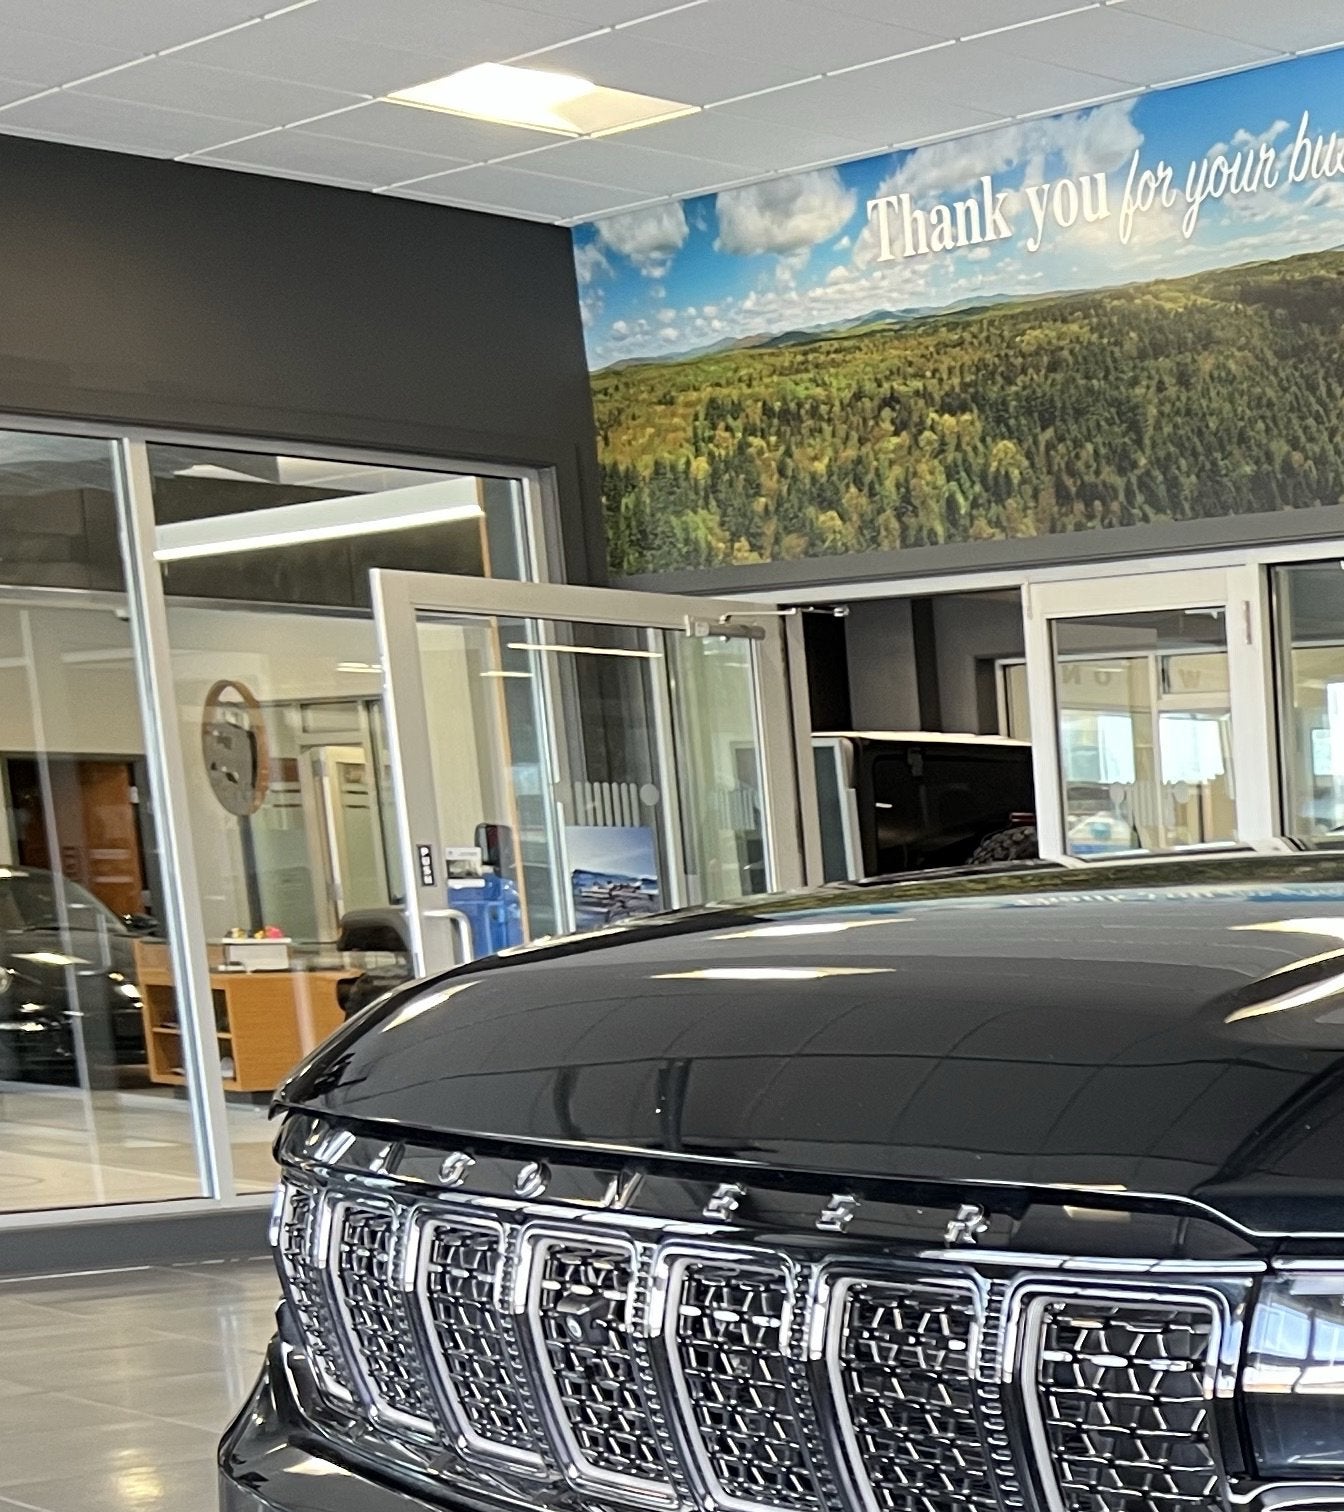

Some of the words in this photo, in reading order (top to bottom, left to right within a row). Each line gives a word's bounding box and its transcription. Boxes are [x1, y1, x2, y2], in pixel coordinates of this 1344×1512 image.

[866, 175, 1015, 264] Thank
[1023, 171, 1112, 253] you
[1117, 149, 1178, 245] for
[1181, 145, 1282, 241] your
